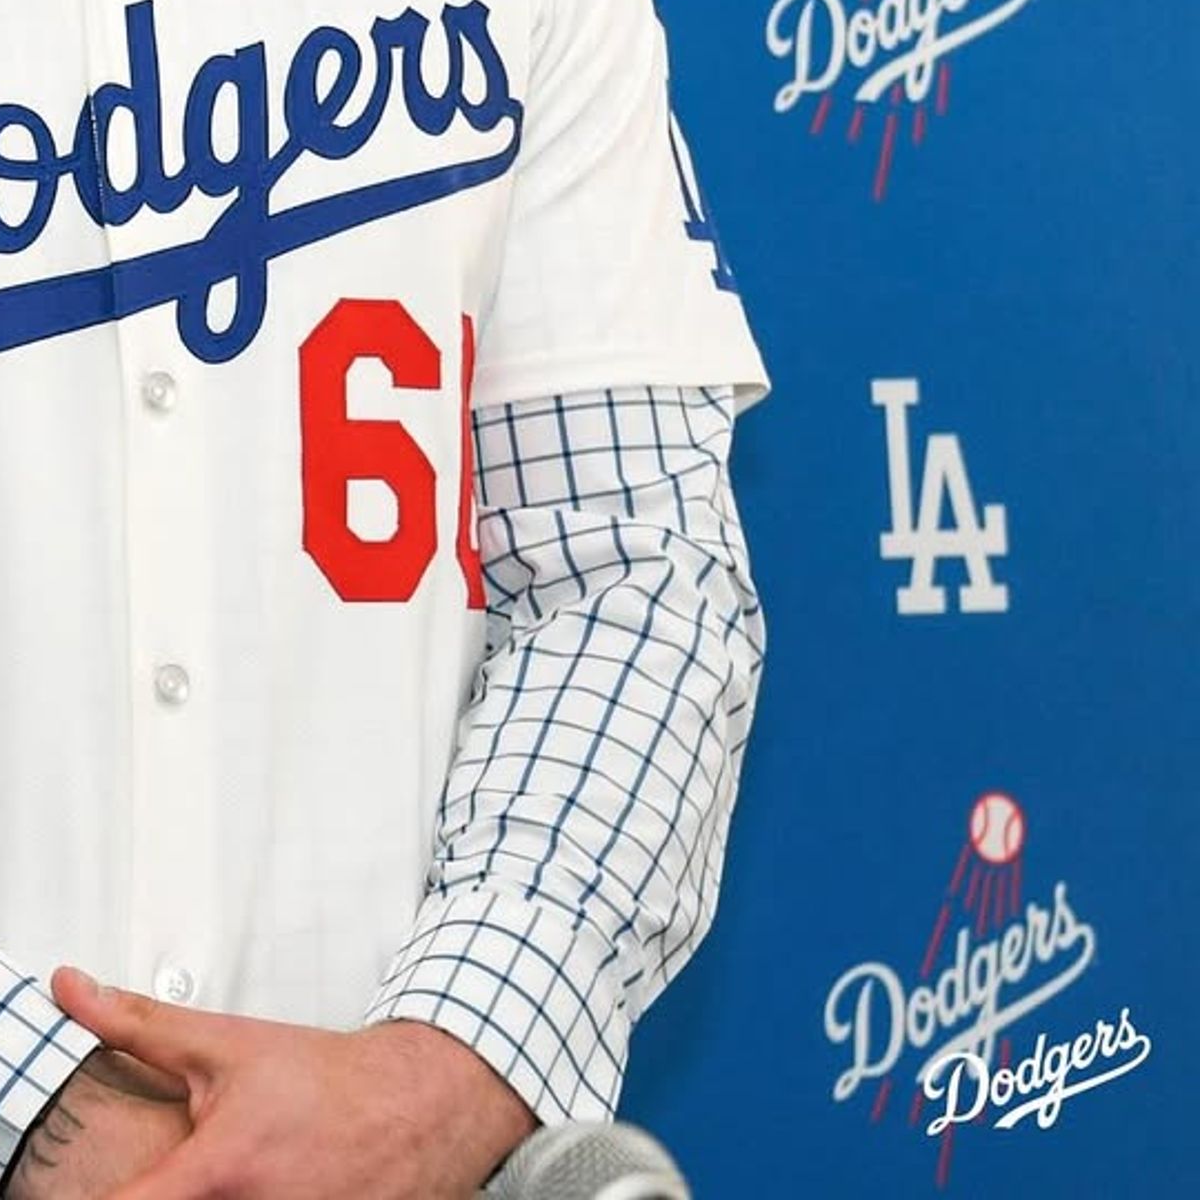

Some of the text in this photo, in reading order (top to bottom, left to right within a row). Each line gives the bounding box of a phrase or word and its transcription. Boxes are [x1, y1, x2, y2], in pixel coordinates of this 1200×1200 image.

[298, 297, 487, 609] 6
[871, 378, 1009, 615] LA
[823, 879, 1096, 1102] Dodgers
